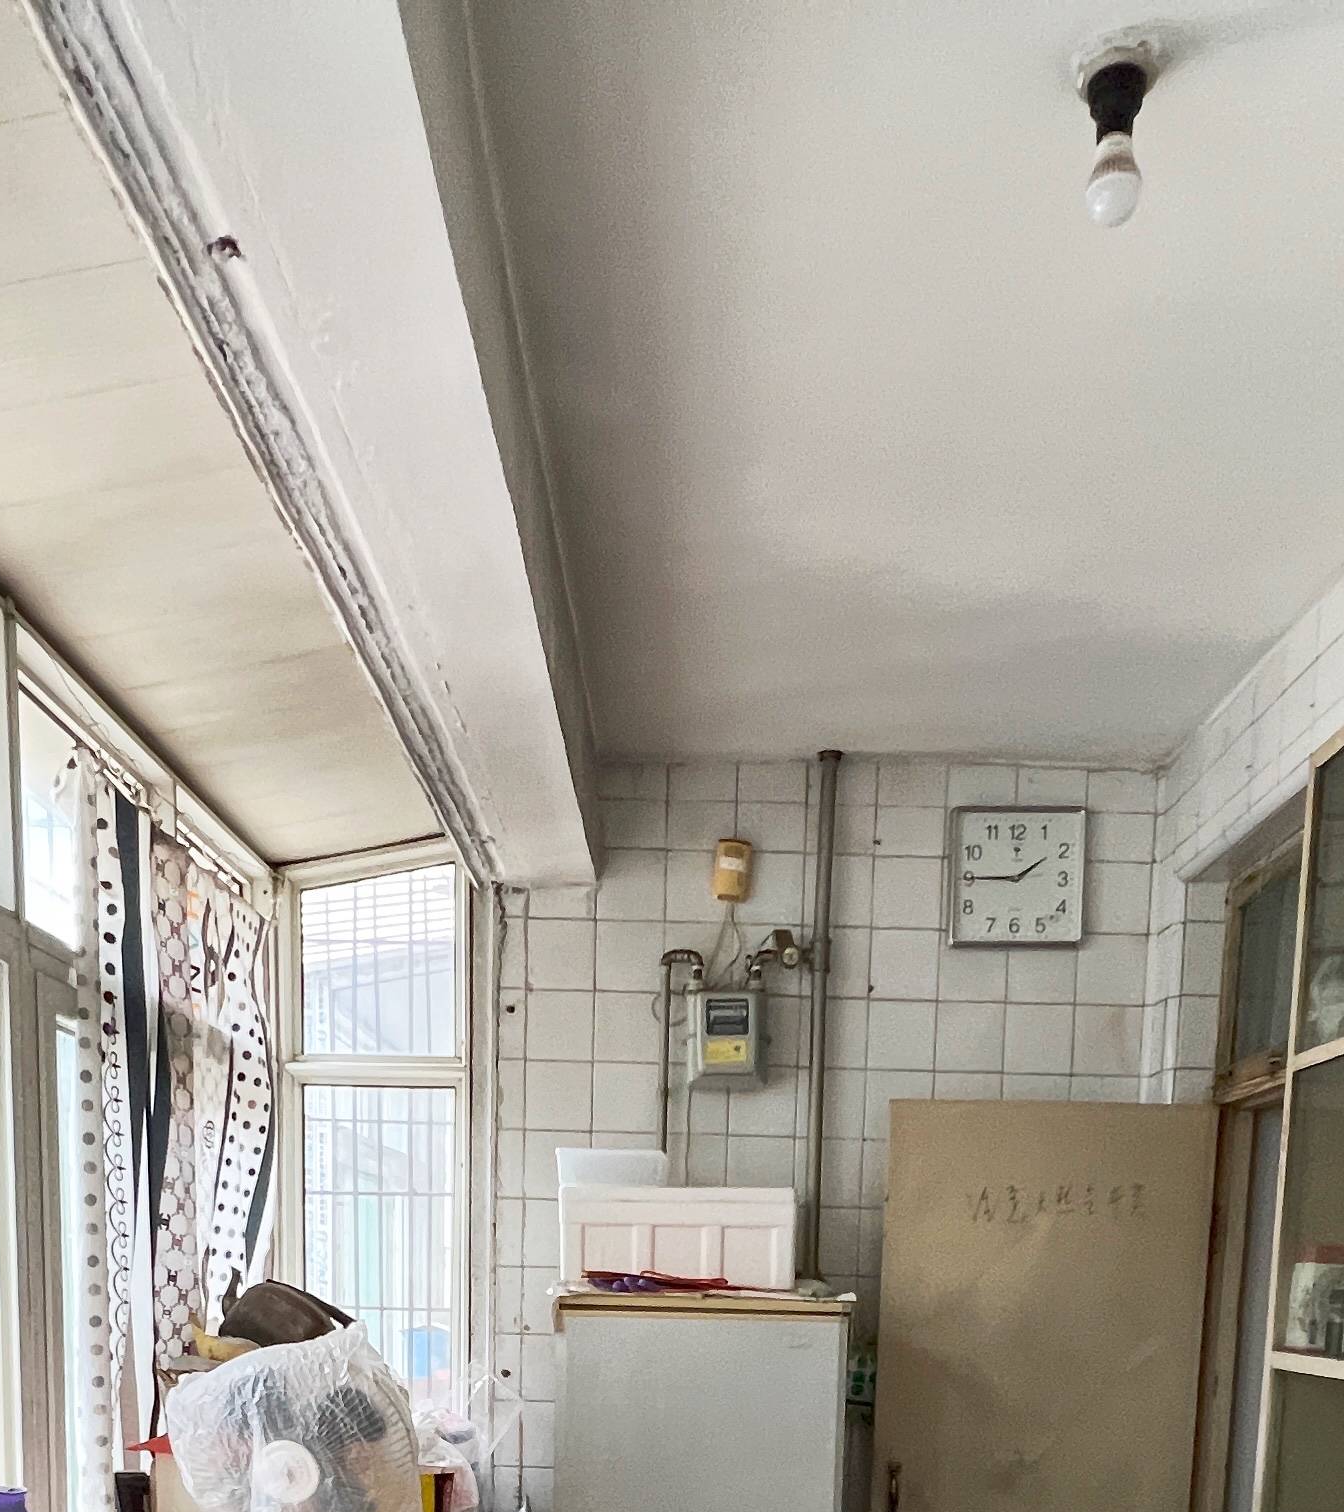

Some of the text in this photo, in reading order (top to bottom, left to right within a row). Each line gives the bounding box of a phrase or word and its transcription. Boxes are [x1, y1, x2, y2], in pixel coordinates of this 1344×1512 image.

[986, 824, 1000, 840] 11
[1009, 824, 1027, 841] 12
[1040, 824, 1048, 840] 1
[965, 844, 982, 861] 10
[1058, 843, 1069, 859] 2
[963, 872, 974, 886] 9
[1058, 871, 1069, 887] 3
[963, 900, 974, 915] 8
[1056, 899, 1067, 914] 4
[986, 918, 997, 933] 7
[1009, 918, 1020, 933] 6
[1035, 918, 1045, 933] 5
